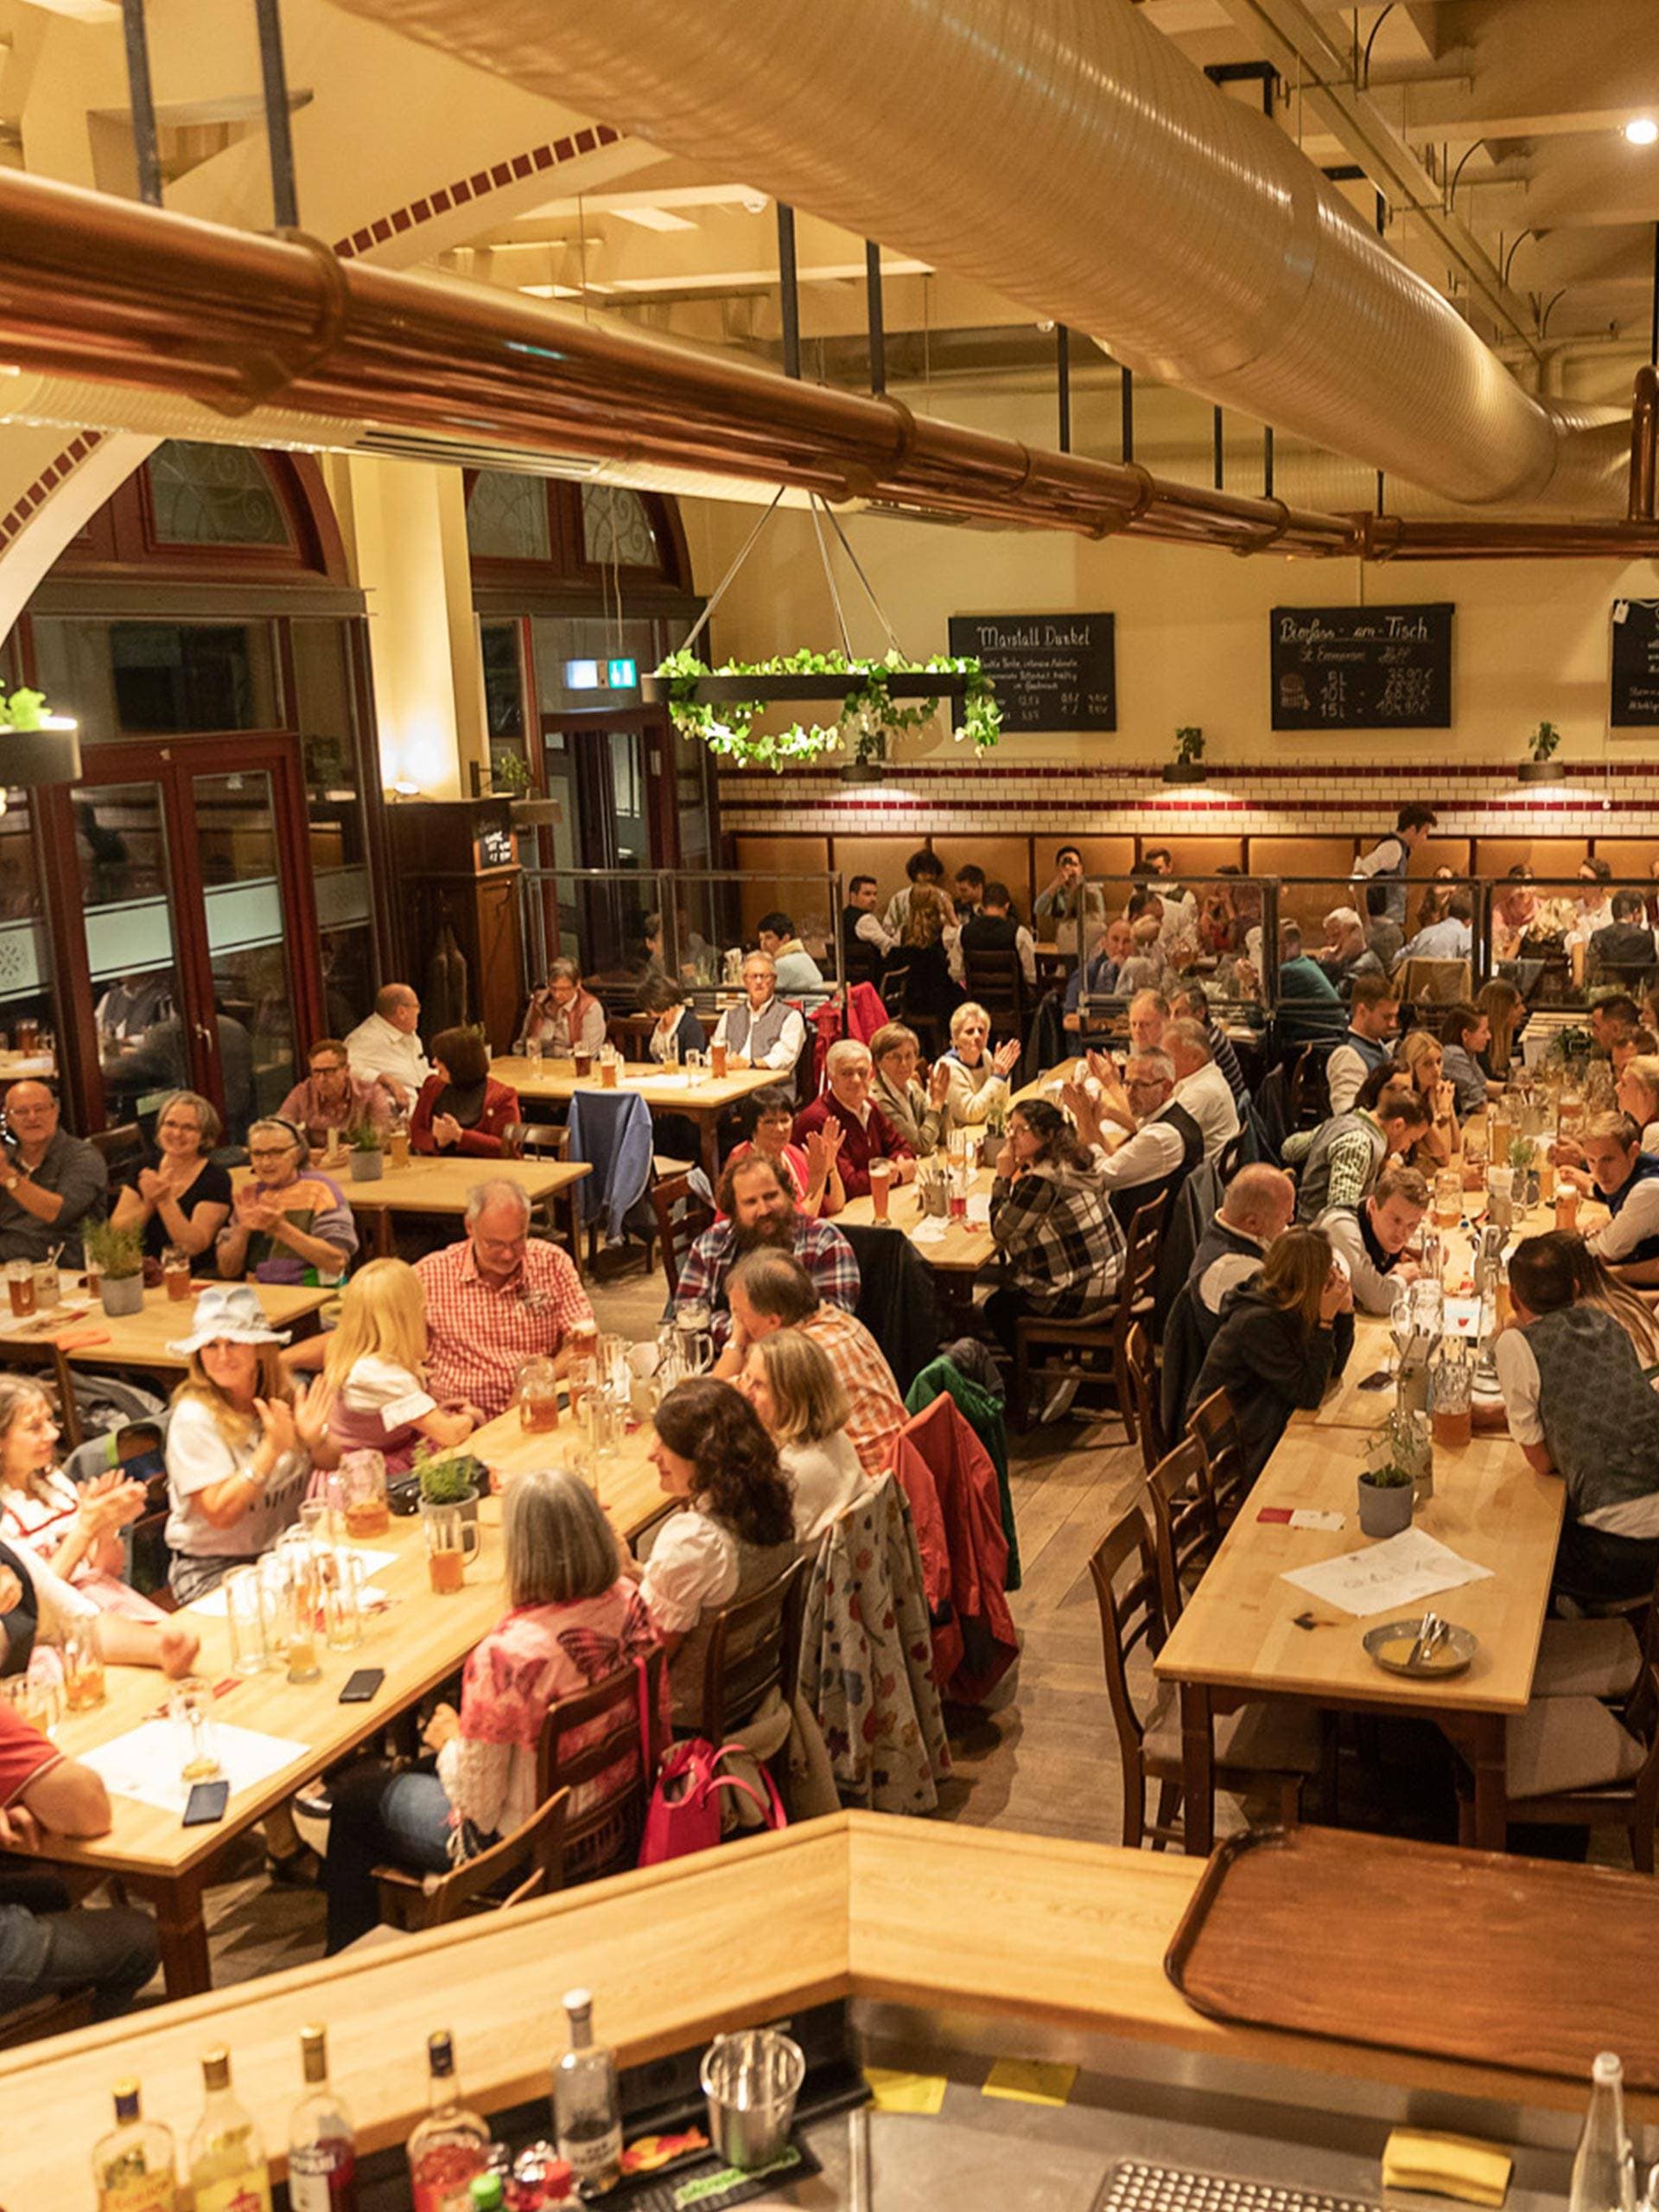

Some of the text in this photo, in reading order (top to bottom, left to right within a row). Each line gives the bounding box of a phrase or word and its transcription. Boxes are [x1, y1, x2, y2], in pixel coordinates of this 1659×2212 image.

[976, 625, 1090, 647] Marstall Dunkel
[1385, 616, 1427, 639] Tisch
